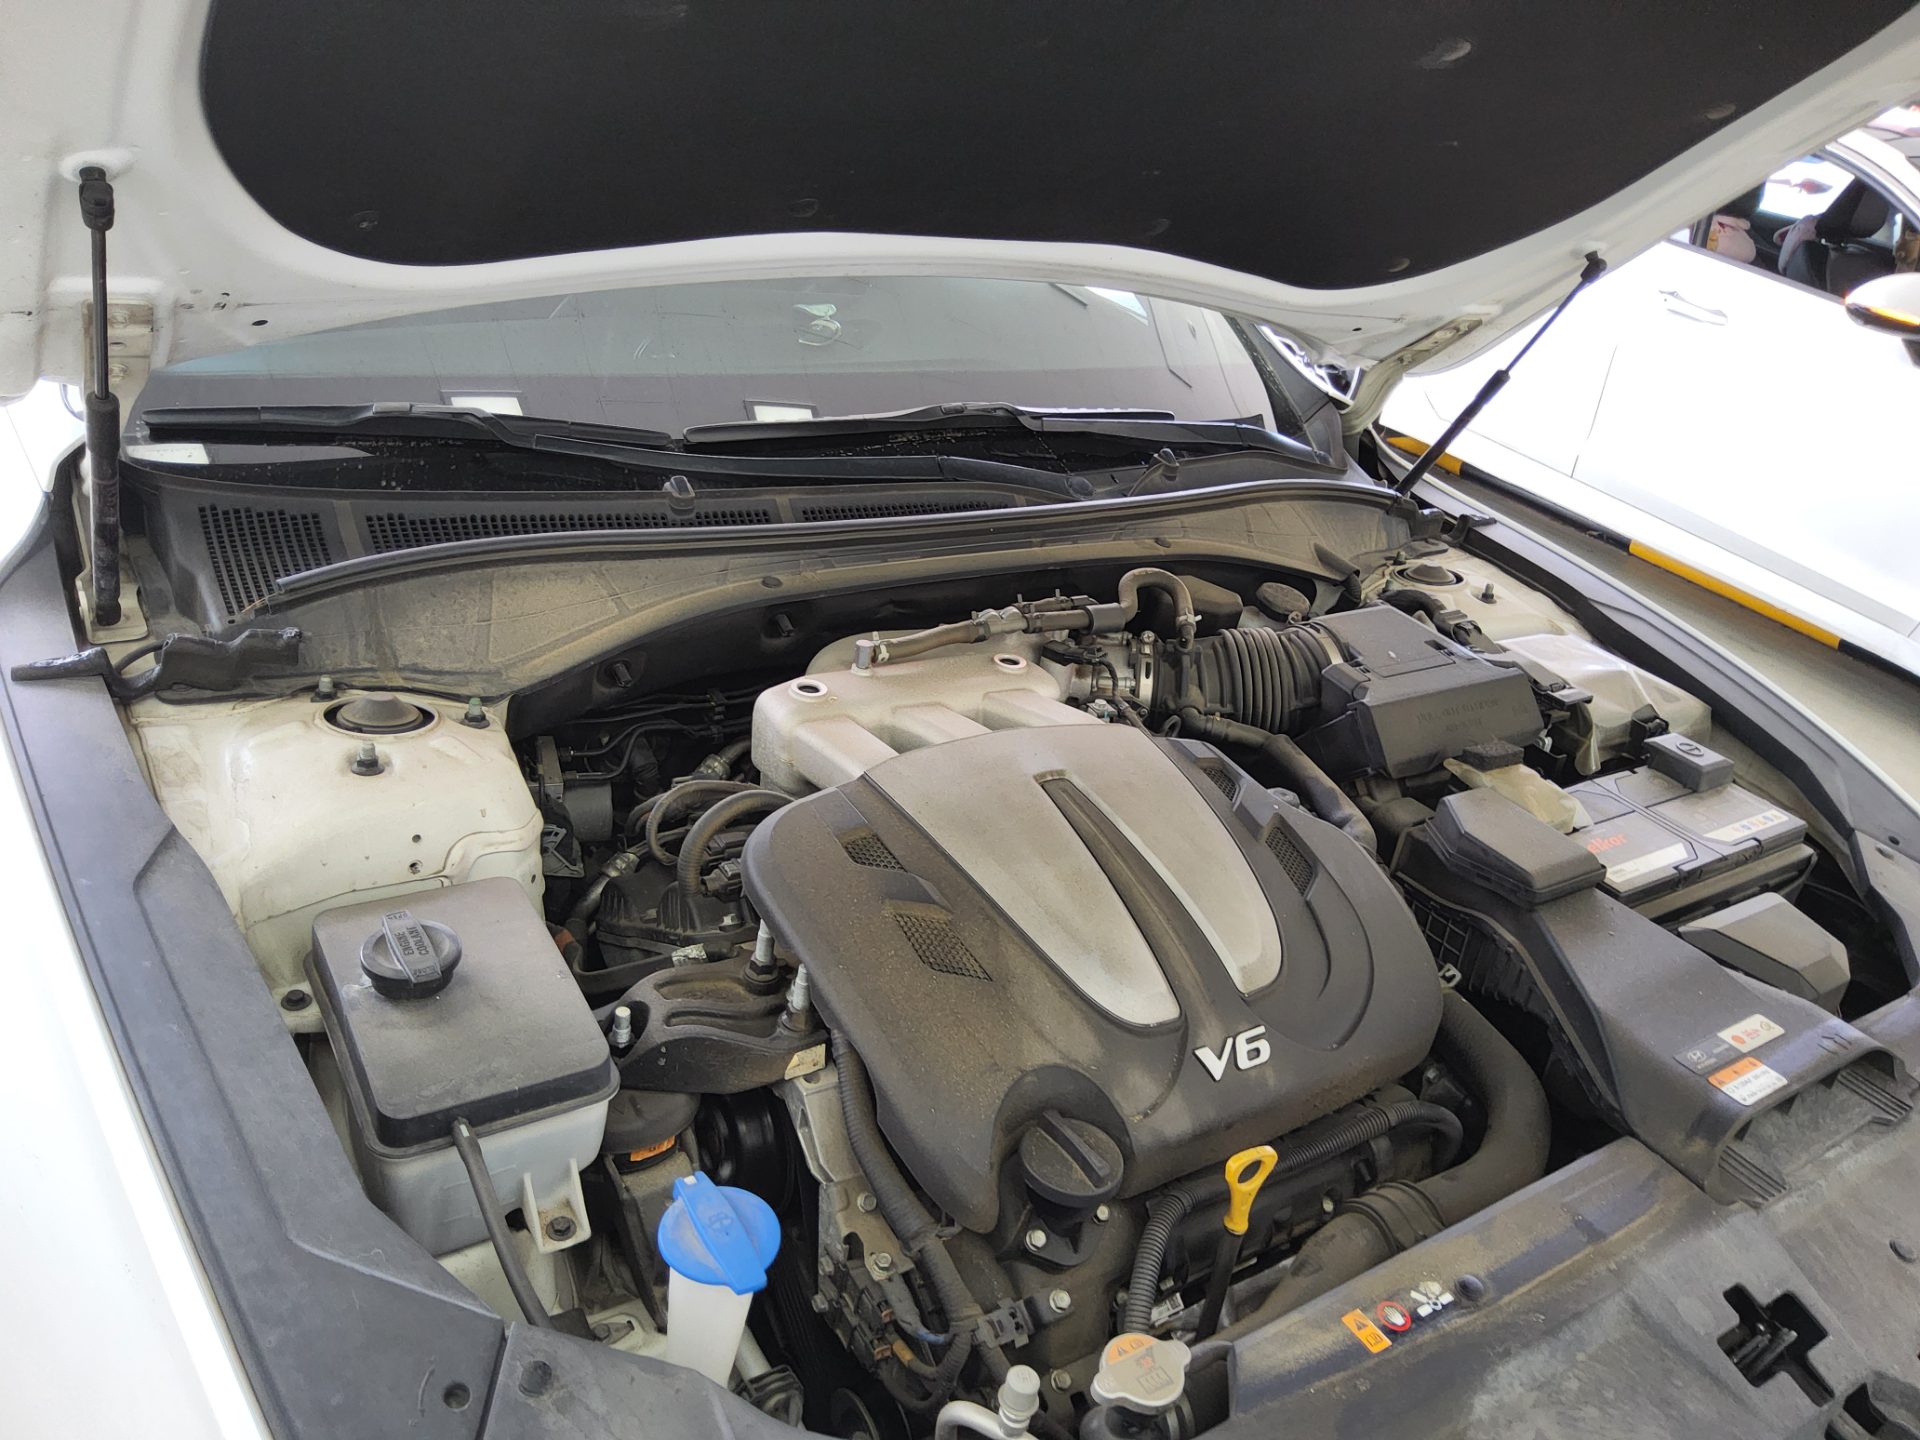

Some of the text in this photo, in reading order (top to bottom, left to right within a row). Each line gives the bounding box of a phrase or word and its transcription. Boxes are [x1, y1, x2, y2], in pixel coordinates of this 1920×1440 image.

[394, 932, 415, 956] ENGINE
[406, 926, 429, 956] COOLANT
[1194, 1025, 1271, 1082] V6
